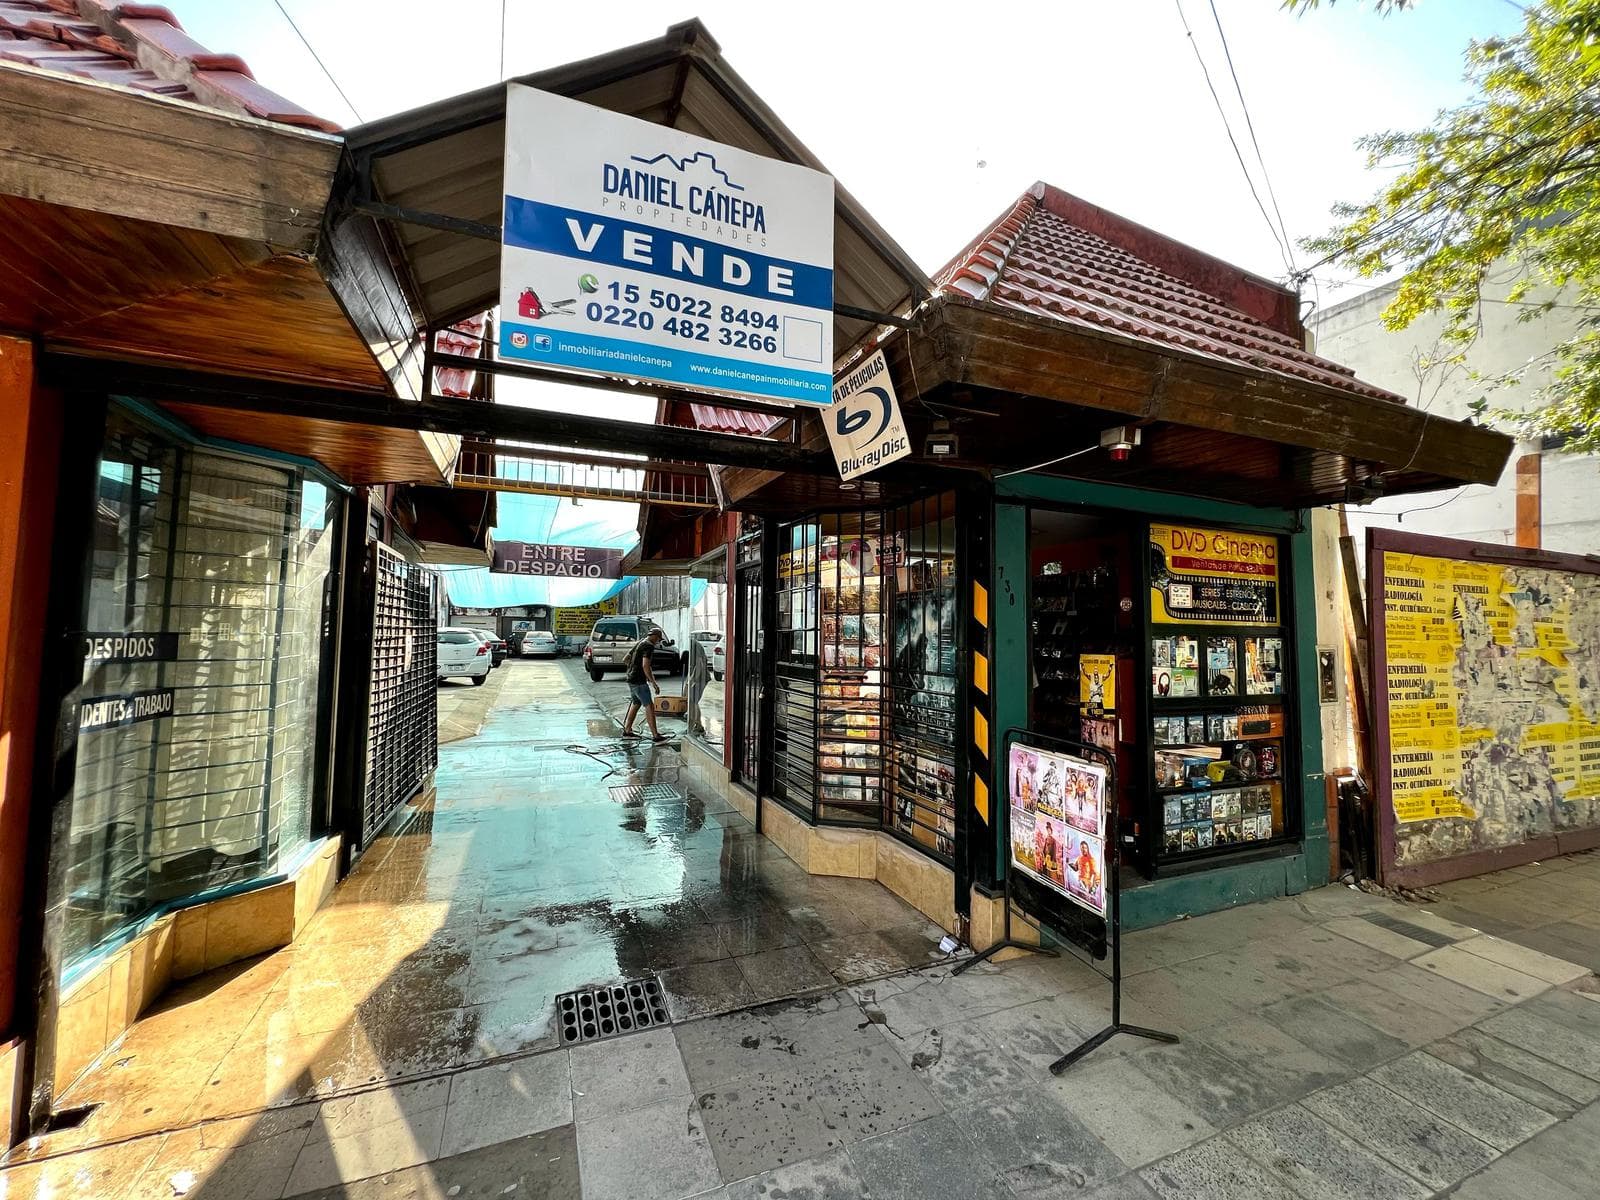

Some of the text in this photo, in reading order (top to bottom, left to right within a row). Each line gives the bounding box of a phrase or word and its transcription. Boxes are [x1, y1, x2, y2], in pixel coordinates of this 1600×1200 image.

[603, 164, 766, 234] DANIEL CÁNEPA
[602, 197, 767, 248] PROPIEDADES
[565, 218, 794, 297] VENDE
[607, 281, 779, 332] 15 5022 8494
[586, 302, 777, 354] 0220 482 3266
[689, 364, 827, 392] www.danielcanepainmobiliaria.com
[840, 382, 850, 399] DE
[848, 355, 884, 393] PELICULAS
[841, 437, 906, 475] Blu-ray Disc
[521, 544, 586, 561] ENTRE
[1171, 529, 1207, 552] DVD
[1212, 534, 1275, 559] Cinema
[503, 559, 602, 578] DESPACIO
[1201, 587, 1221, 597] SERIES
[1385, 576, 1425, 588] ENFERMERÍA
[1192, 600, 1227, 609] MUSICALES
[1385, 590, 1423, 601] RADIOLOGÍA
[1388, 664, 1427, 674] ENFERMERÍA
[134, 693, 171, 717] TRABAJO
[1393, 751, 1433, 763] ENFERMERÍA
[1393, 765, 1432, 777] RADIOLOGÍA
